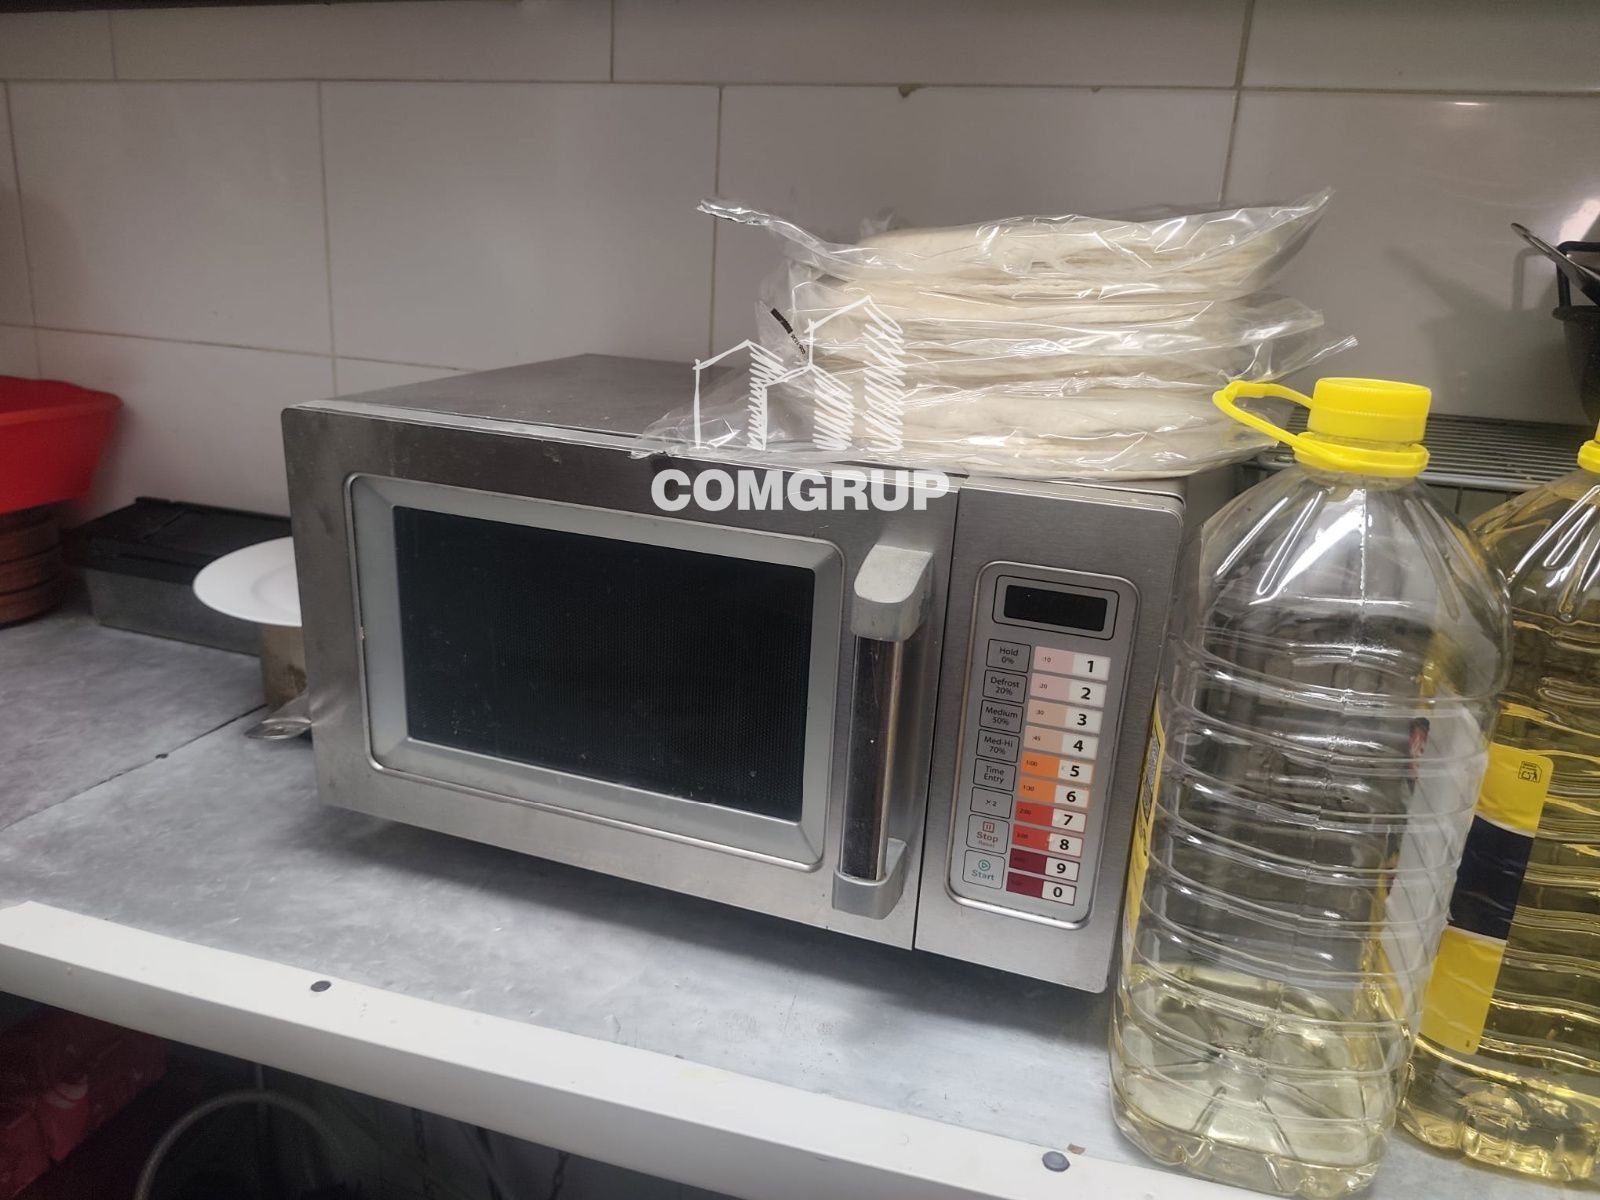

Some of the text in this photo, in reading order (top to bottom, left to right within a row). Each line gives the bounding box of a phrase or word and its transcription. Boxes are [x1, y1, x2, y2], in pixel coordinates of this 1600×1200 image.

[1000, 647, 1019, 657] Hold
[1001, 656, 1015, 665] 0%
[1087, 660, 1094, 673] 1
[990, 676, 1020, 689] Defrost
[995, 686, 1013, 696] 20%
[1080, 687, 1091, 700] 2
[985, 706, 1018, 719] Medium
[1077, 713, 1087, 726] 3
[984, 735, 1013, 748] Med-Hi
[1072, 740, 1084, 752] 4
[989, 745, 1006, 755] 70%
[985, 765, 1005, 776] Time
[1069, 765, 1080, 777] 5
[983, 772, 1005, 784] Entry
[1066, 791, 1077, 803] 6
[1063, 814, 1073, 826] 7
[976, 831, 999, 843] Stop
[1059, 839, 1070, 851] 8
[1056, 862, 1066, 874] 9
[971, 869, 995, 881] Start
[1053, 887, 1063, 898] 0
